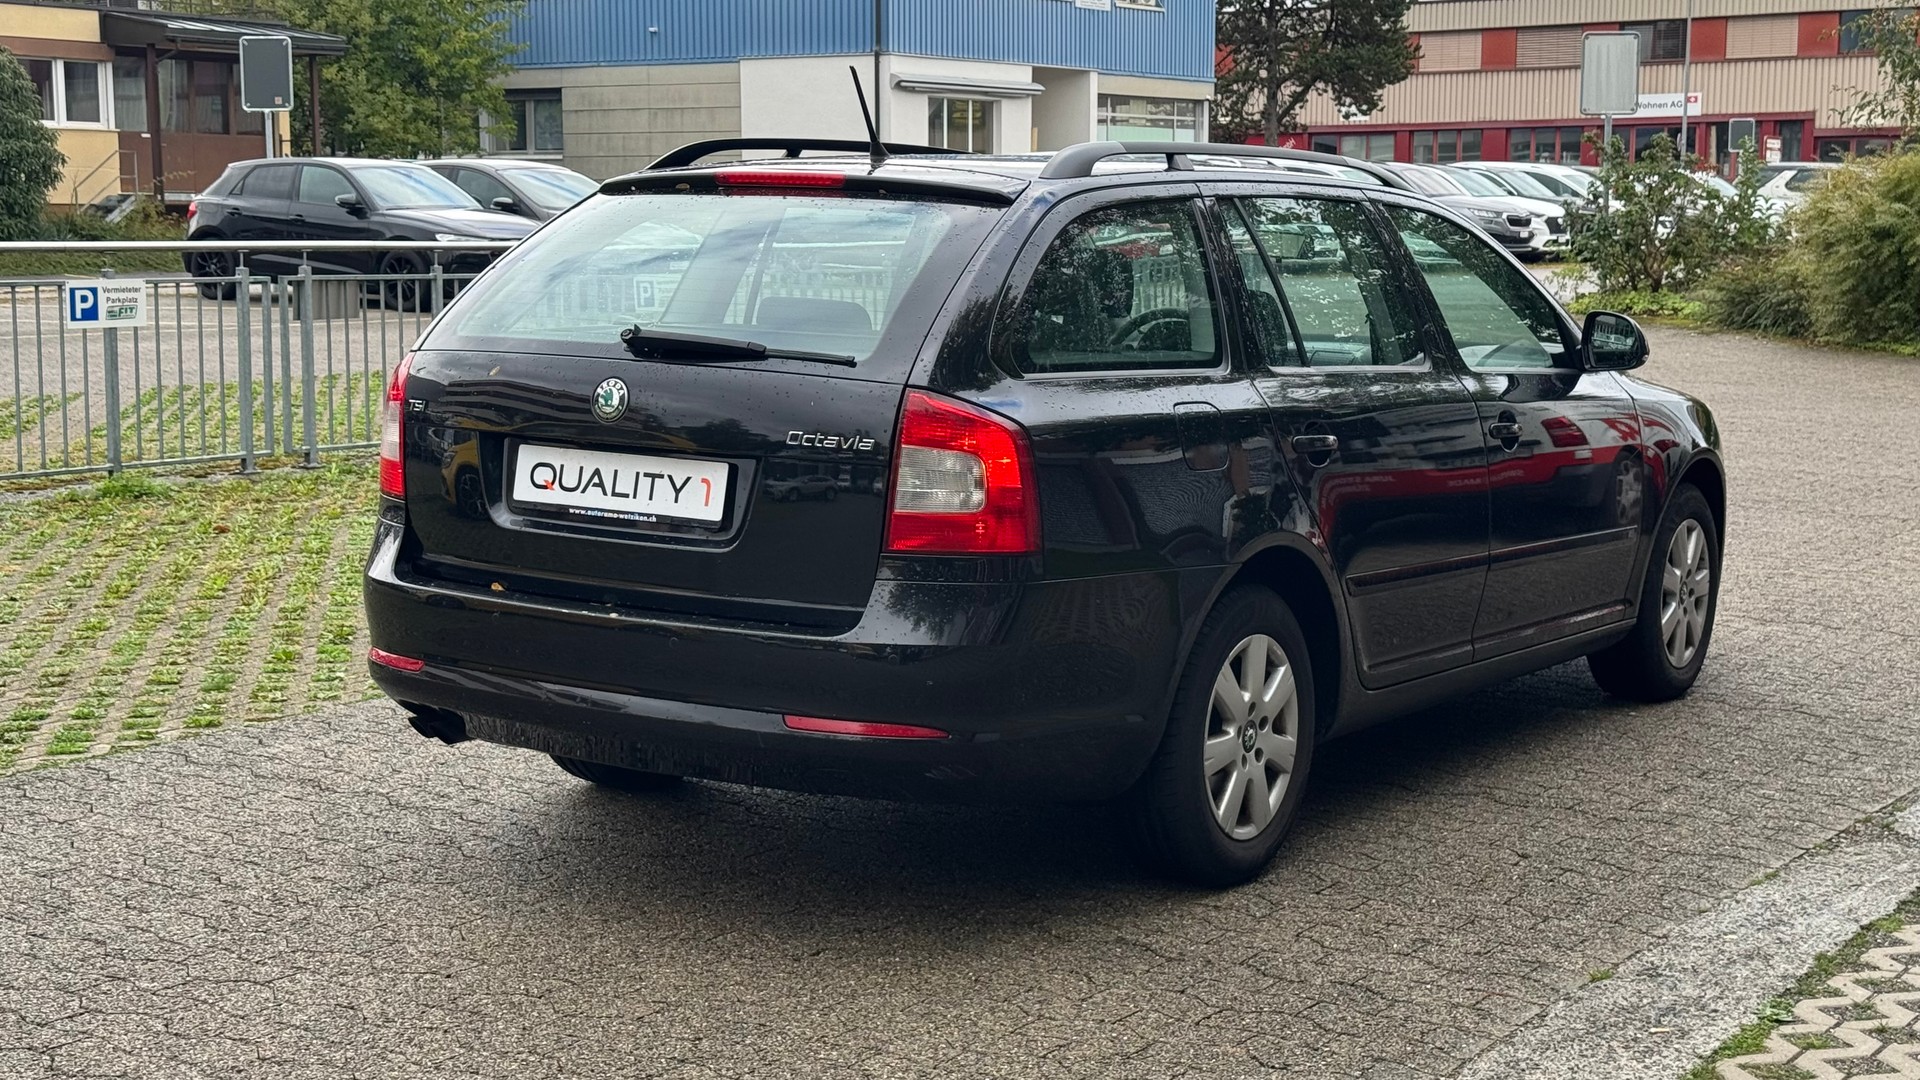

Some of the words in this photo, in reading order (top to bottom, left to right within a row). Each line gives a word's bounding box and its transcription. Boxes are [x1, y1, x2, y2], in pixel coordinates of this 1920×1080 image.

[1670, 100, 1683, 108] AG
[102, 286, 141, 294] Vermieteter
[74, 289, 94, 319] P
[106, 296, 138, 305] Parkplatz
[408, 399, 426, 412] TSI
[785, 430, 875, 451] Octavia
[530, 461, 693, 504] QUALITY
[700, 477, 711, 507] 1
